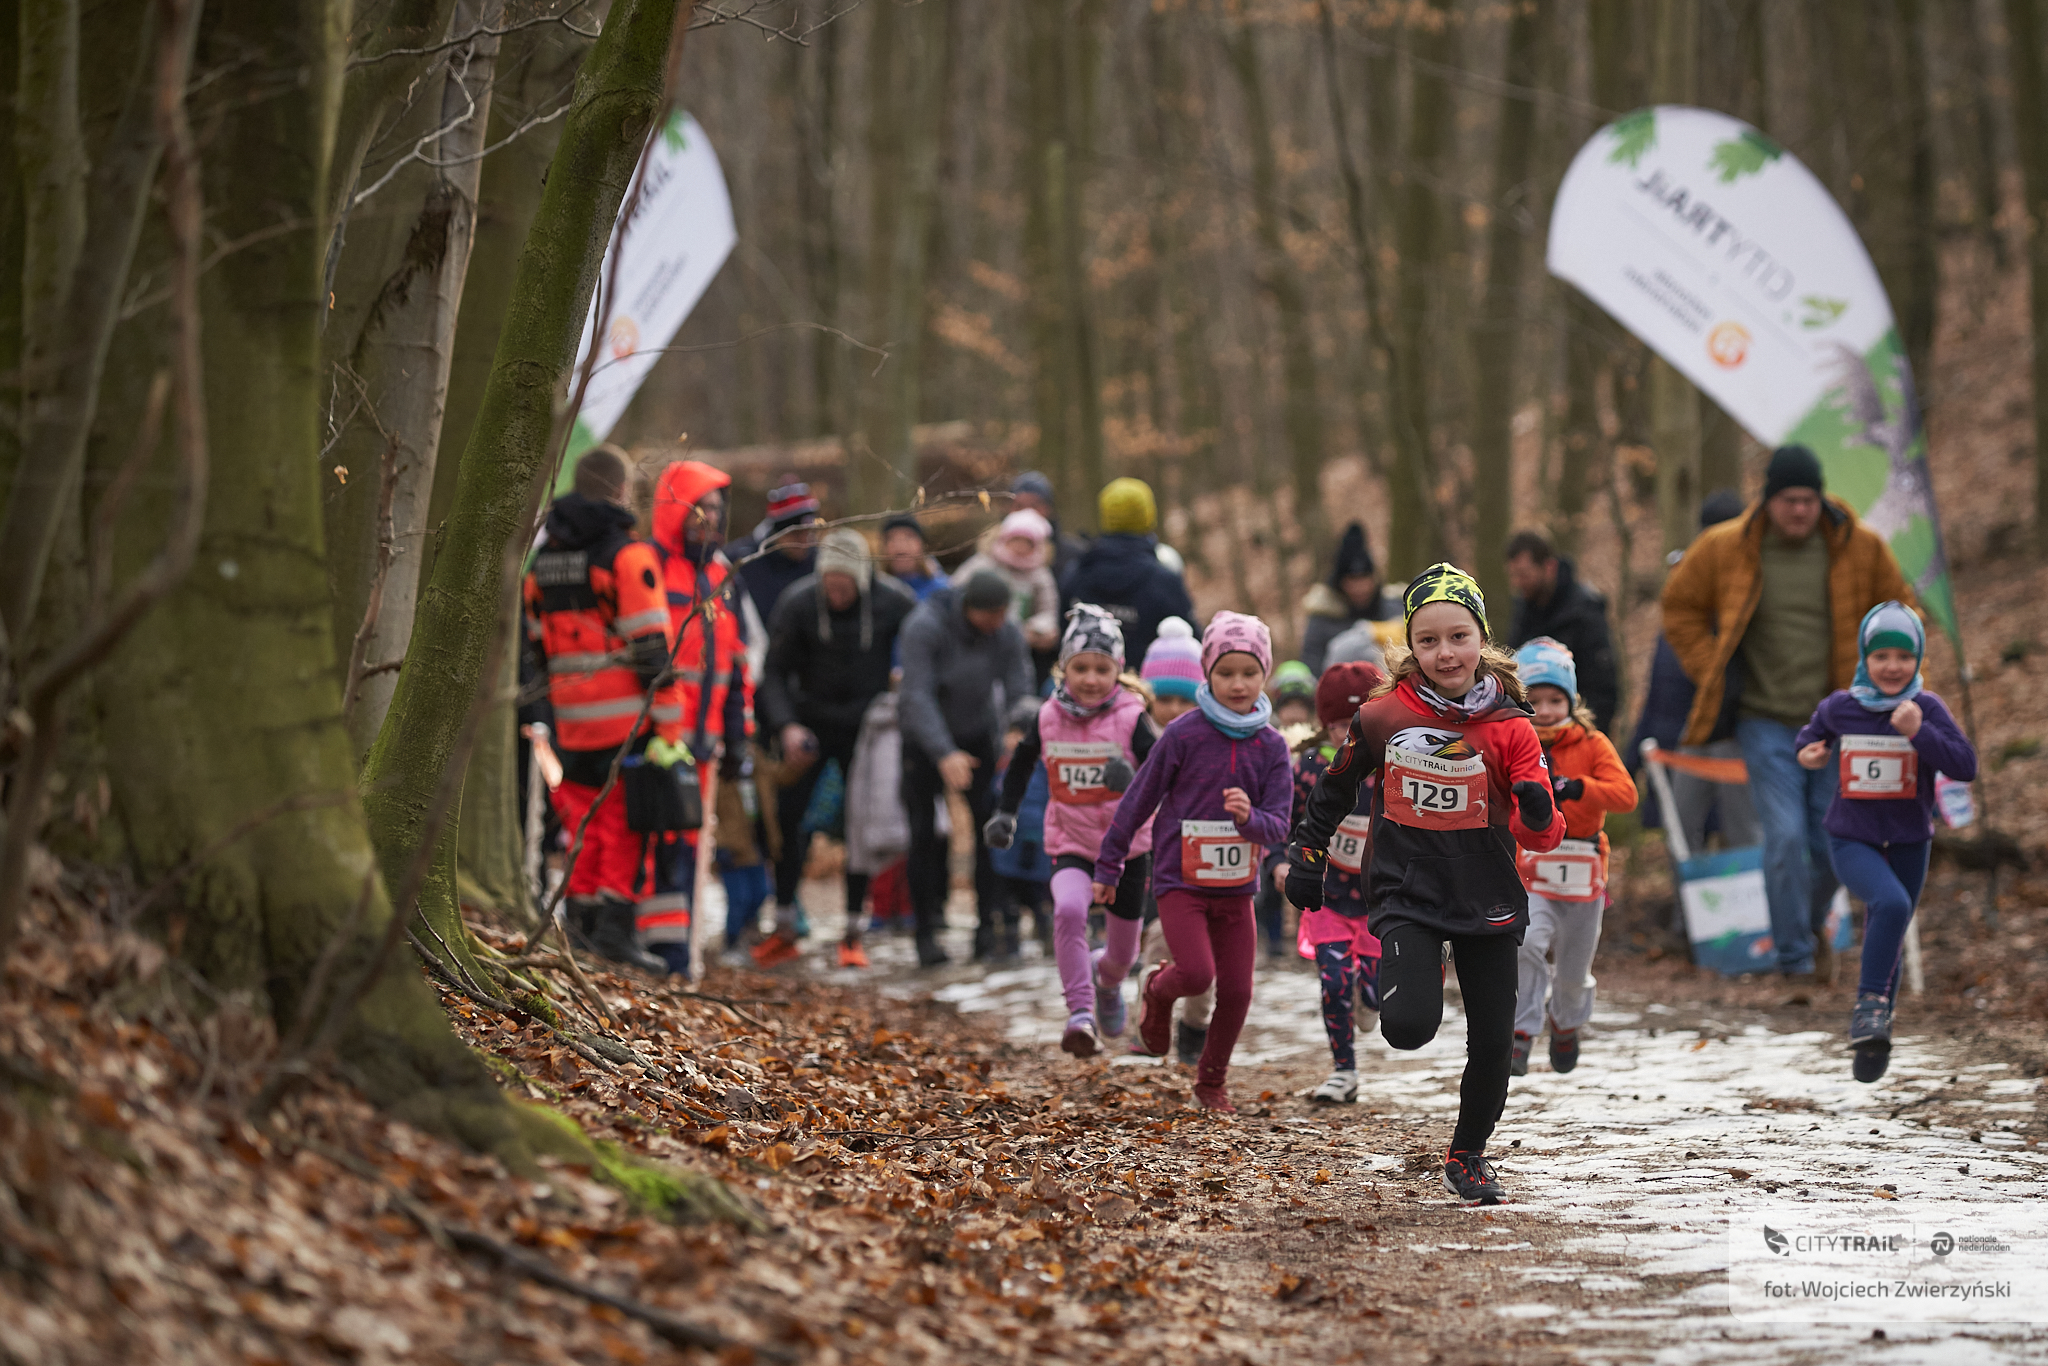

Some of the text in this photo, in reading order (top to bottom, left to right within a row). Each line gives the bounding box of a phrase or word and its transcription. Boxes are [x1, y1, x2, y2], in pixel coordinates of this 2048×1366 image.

[1065, 767, 1104, 785] 142
[1450, 763, 1477, 773] Junior
[1868, 760, 1880, 779] 6
[1408, 781, 1459, 809] 129
[1336, 833, 1357, 855] 18
[1215, 846, 1241, 866] 10
[1559, 865, 1567, 882] 1
